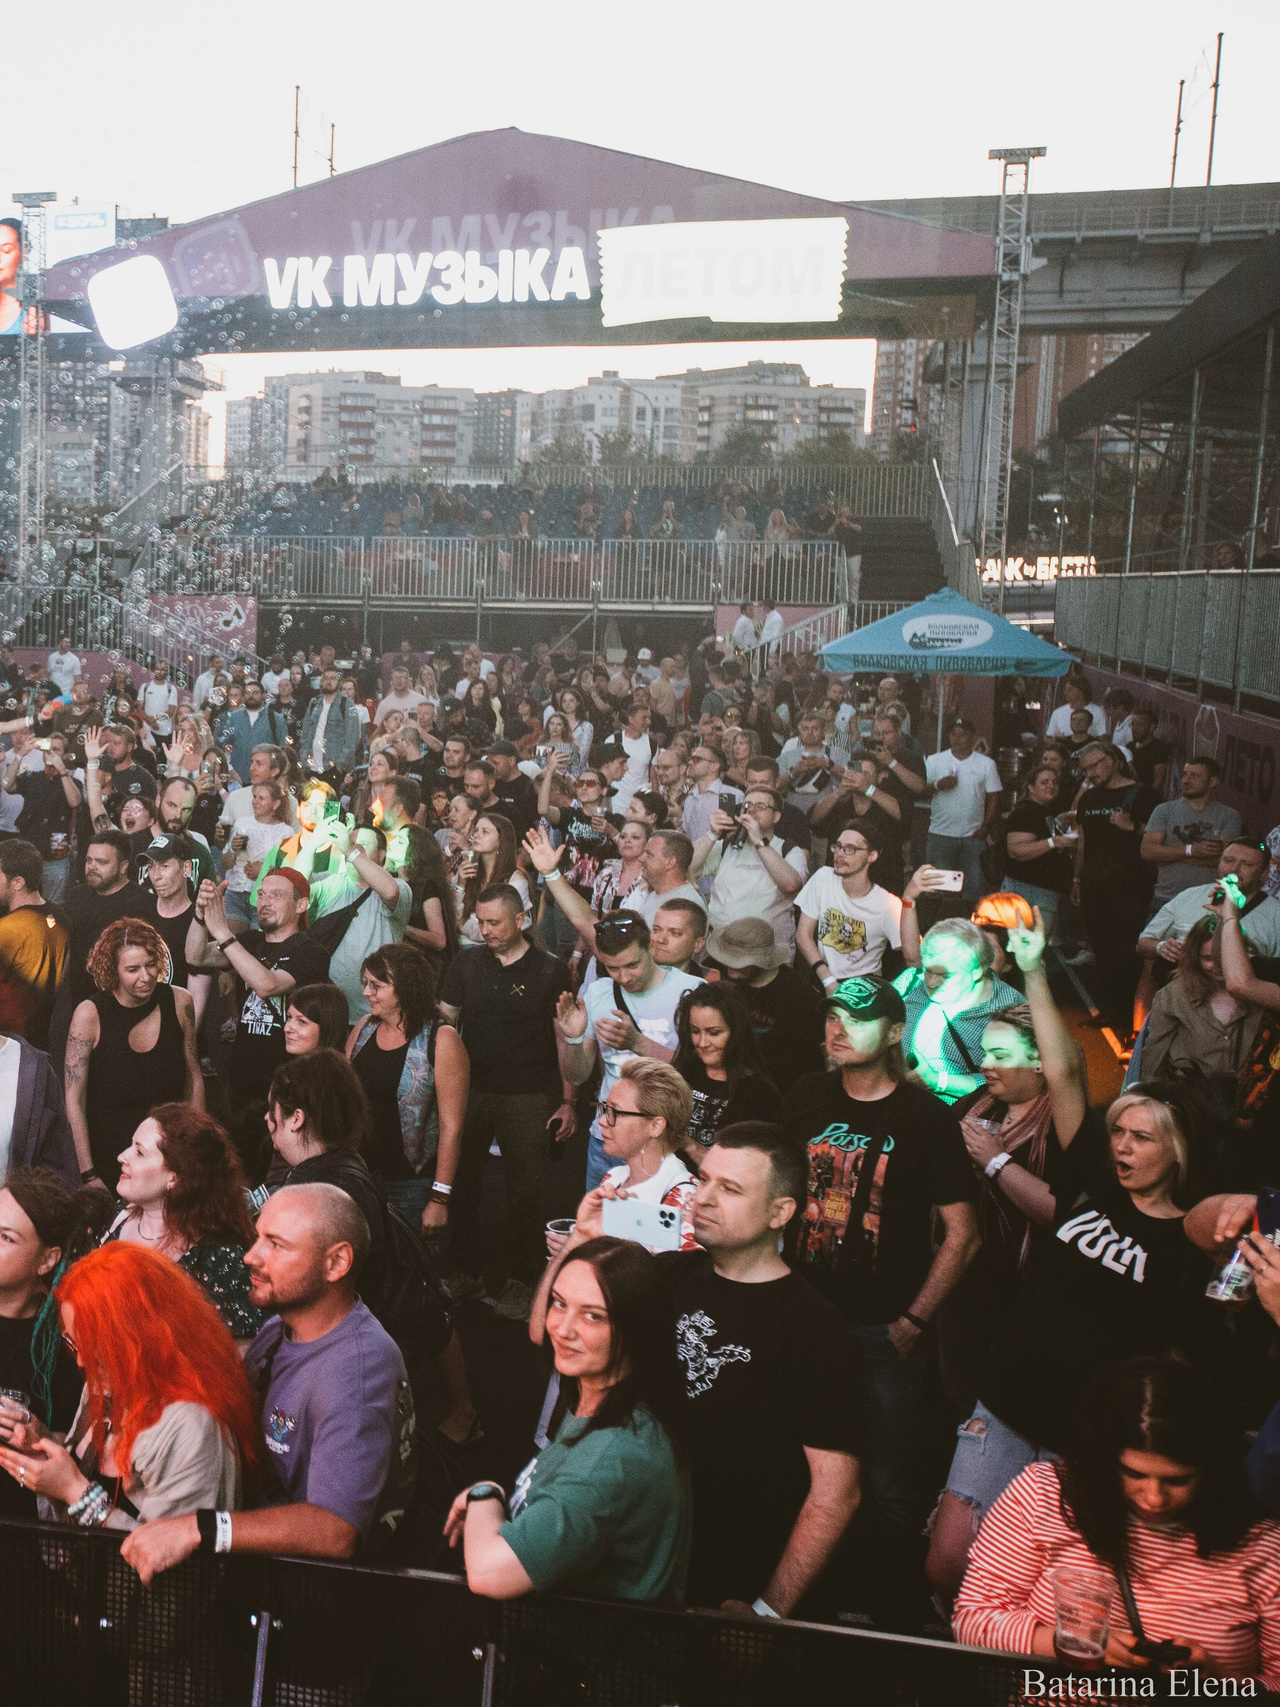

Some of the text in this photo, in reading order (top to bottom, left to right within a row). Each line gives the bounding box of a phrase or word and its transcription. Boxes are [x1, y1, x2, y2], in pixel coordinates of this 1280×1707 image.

[263, 246, 591, 309] VK МУЗЫКА
[615, 245, 826, 300] ЛЕТОМ
[853, 654, 1007, 672] ВОЛКОВСКАЯ ПИВОВАРНЯ
[247, 1021, 273, 1036] TIWAZ
[824, 1199, 847, 1212] DIRTY
